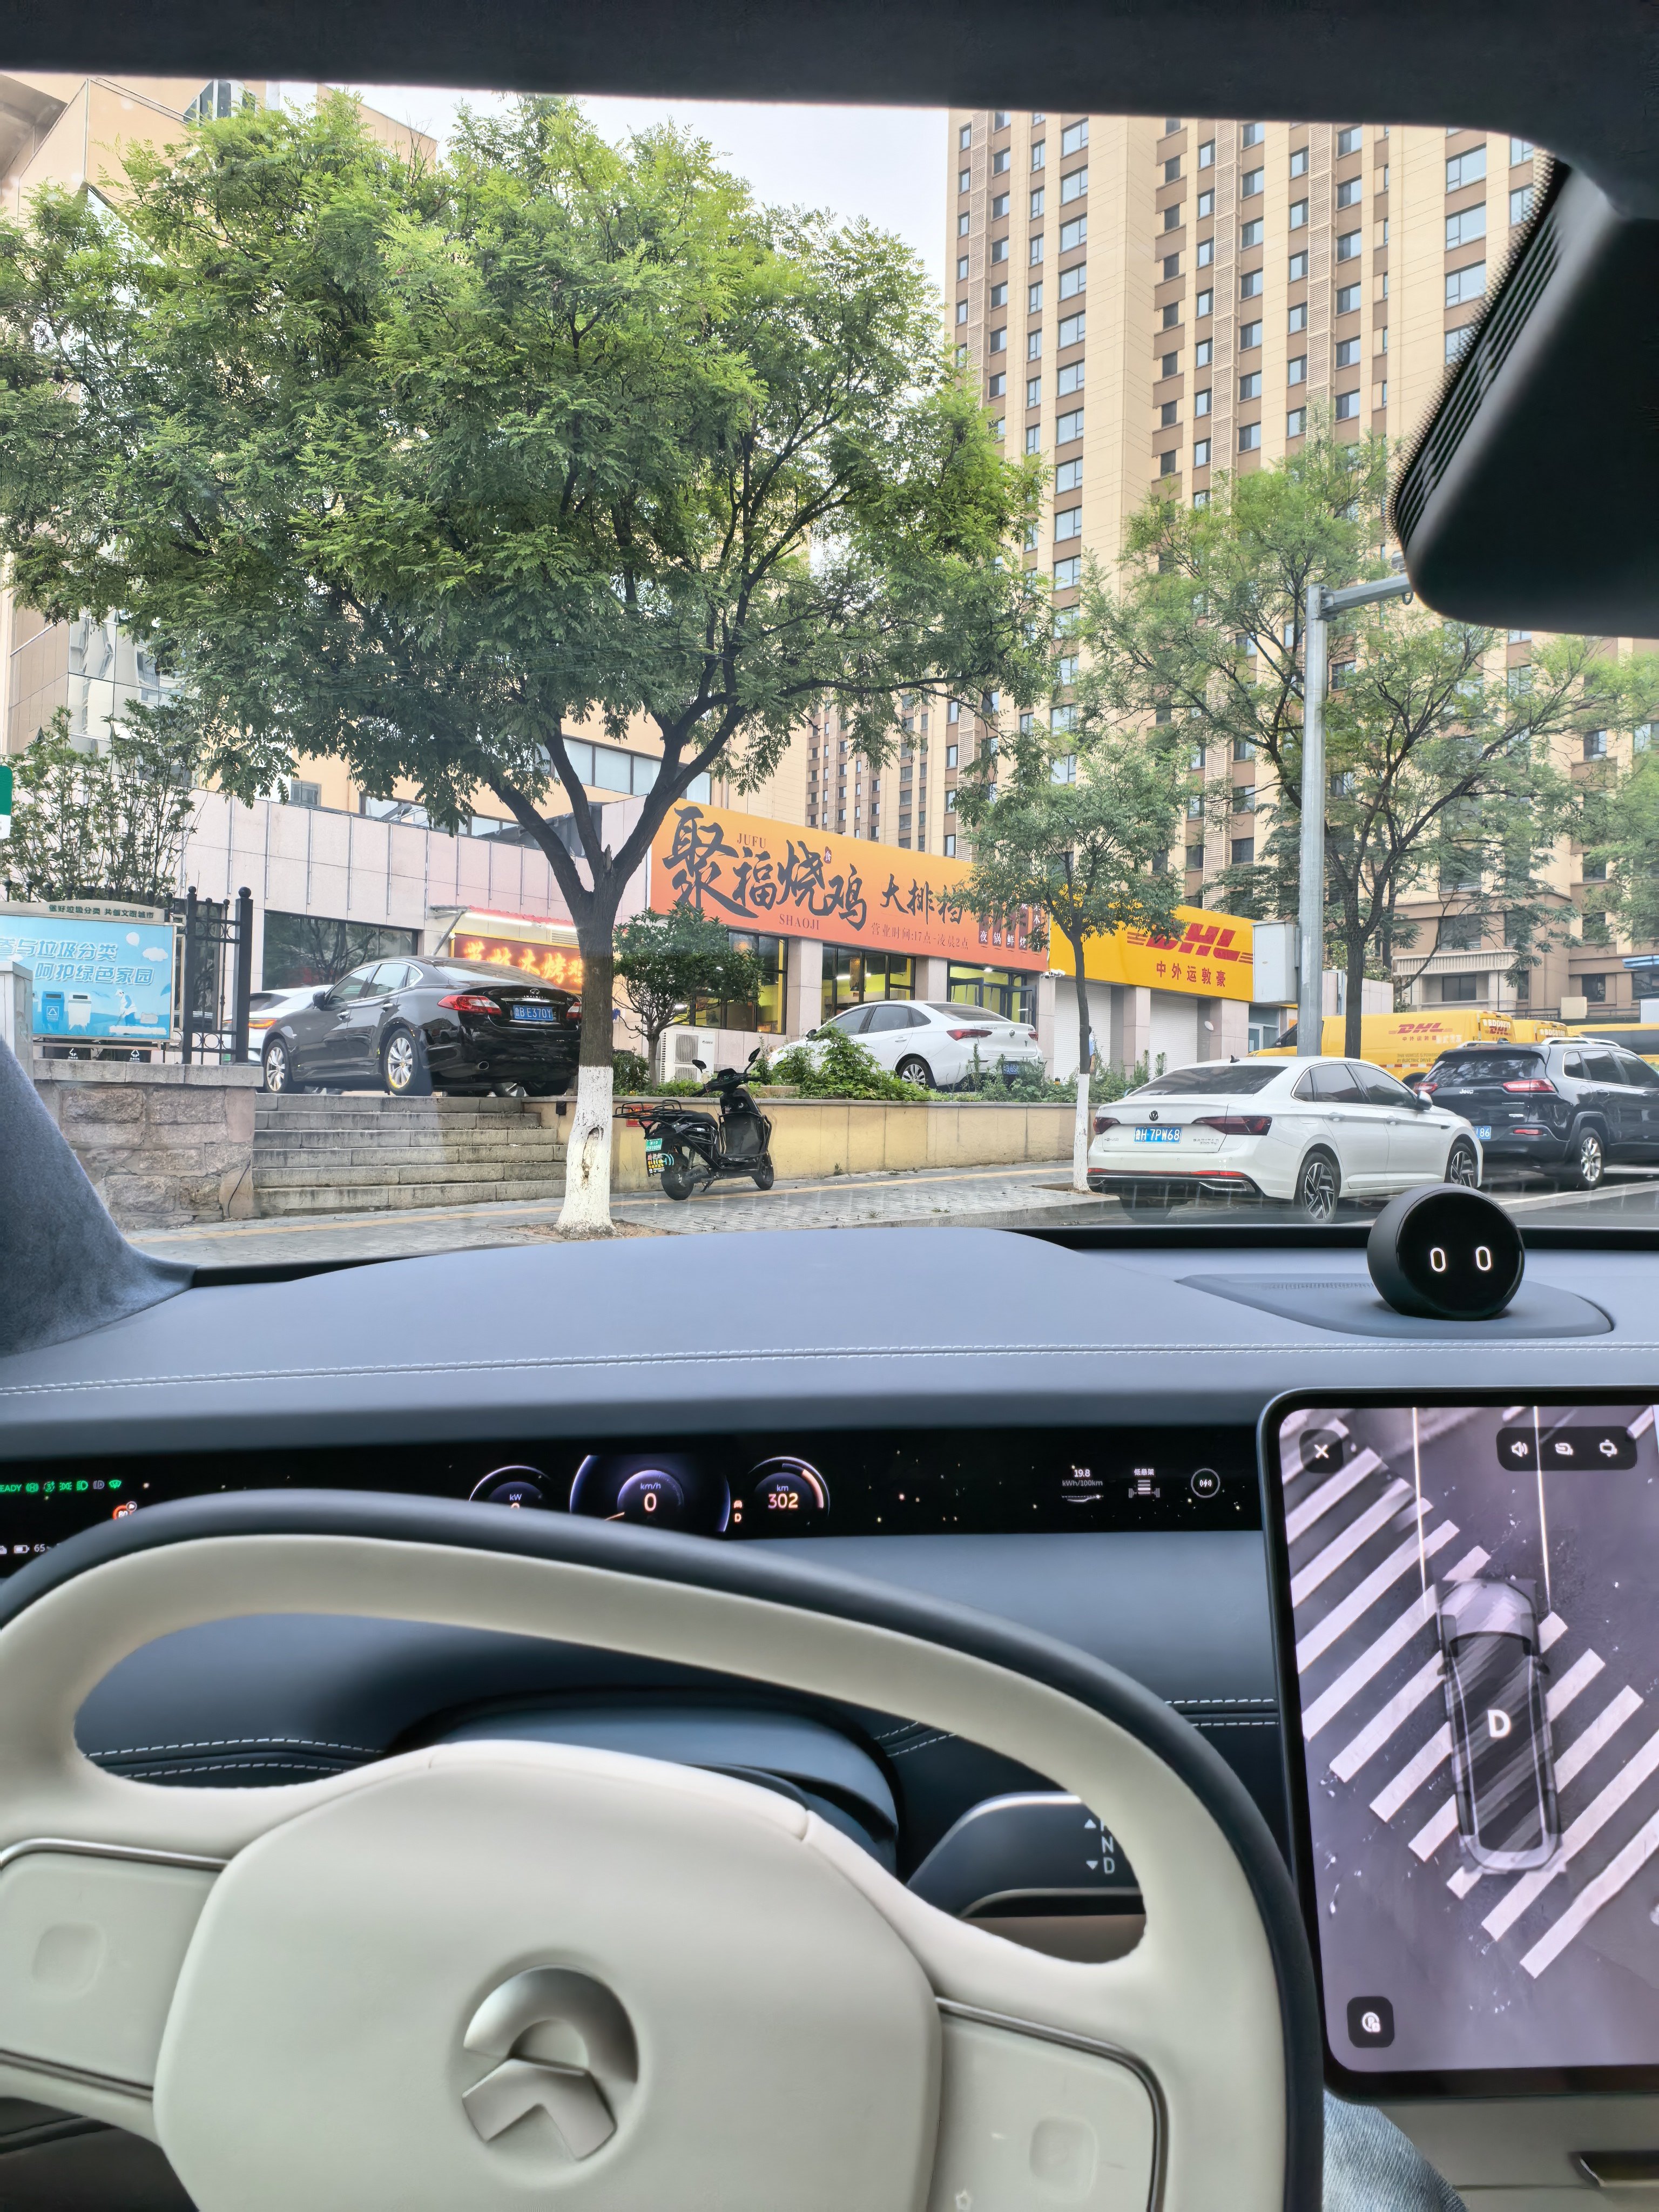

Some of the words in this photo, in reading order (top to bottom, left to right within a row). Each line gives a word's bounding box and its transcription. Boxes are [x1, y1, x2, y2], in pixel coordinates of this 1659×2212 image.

[737, 833, 766, 849] JUFU
[663, 806, 867, 932] 聚福烧鸡
[880, 873, 963, 925] 大排档
[779, 913, 820, 930] SHAOJI
[1145, 922, 1241, 962] DHL
[34, 961, 155, 986] 呵护绿色家园
[1156, 960, 1226, 988] 中外运敦豪
[1397, 1022, 1444, 1034] DHL
[1074, 1469, 1090, 1478] 19.8
[640, 1482, 661, 1490] km/h
[777, 1483, 788, 1492] km
[644, 1492, 657, 1512] 0
[768, 1492, 798, 1509] 302
[734, 1513, 741, 1522] D
[1487, 1709, 1512, 1737] D
[1101, 1836, 1115, 1853] N
[1103, 1857, 1115, 1874] D
